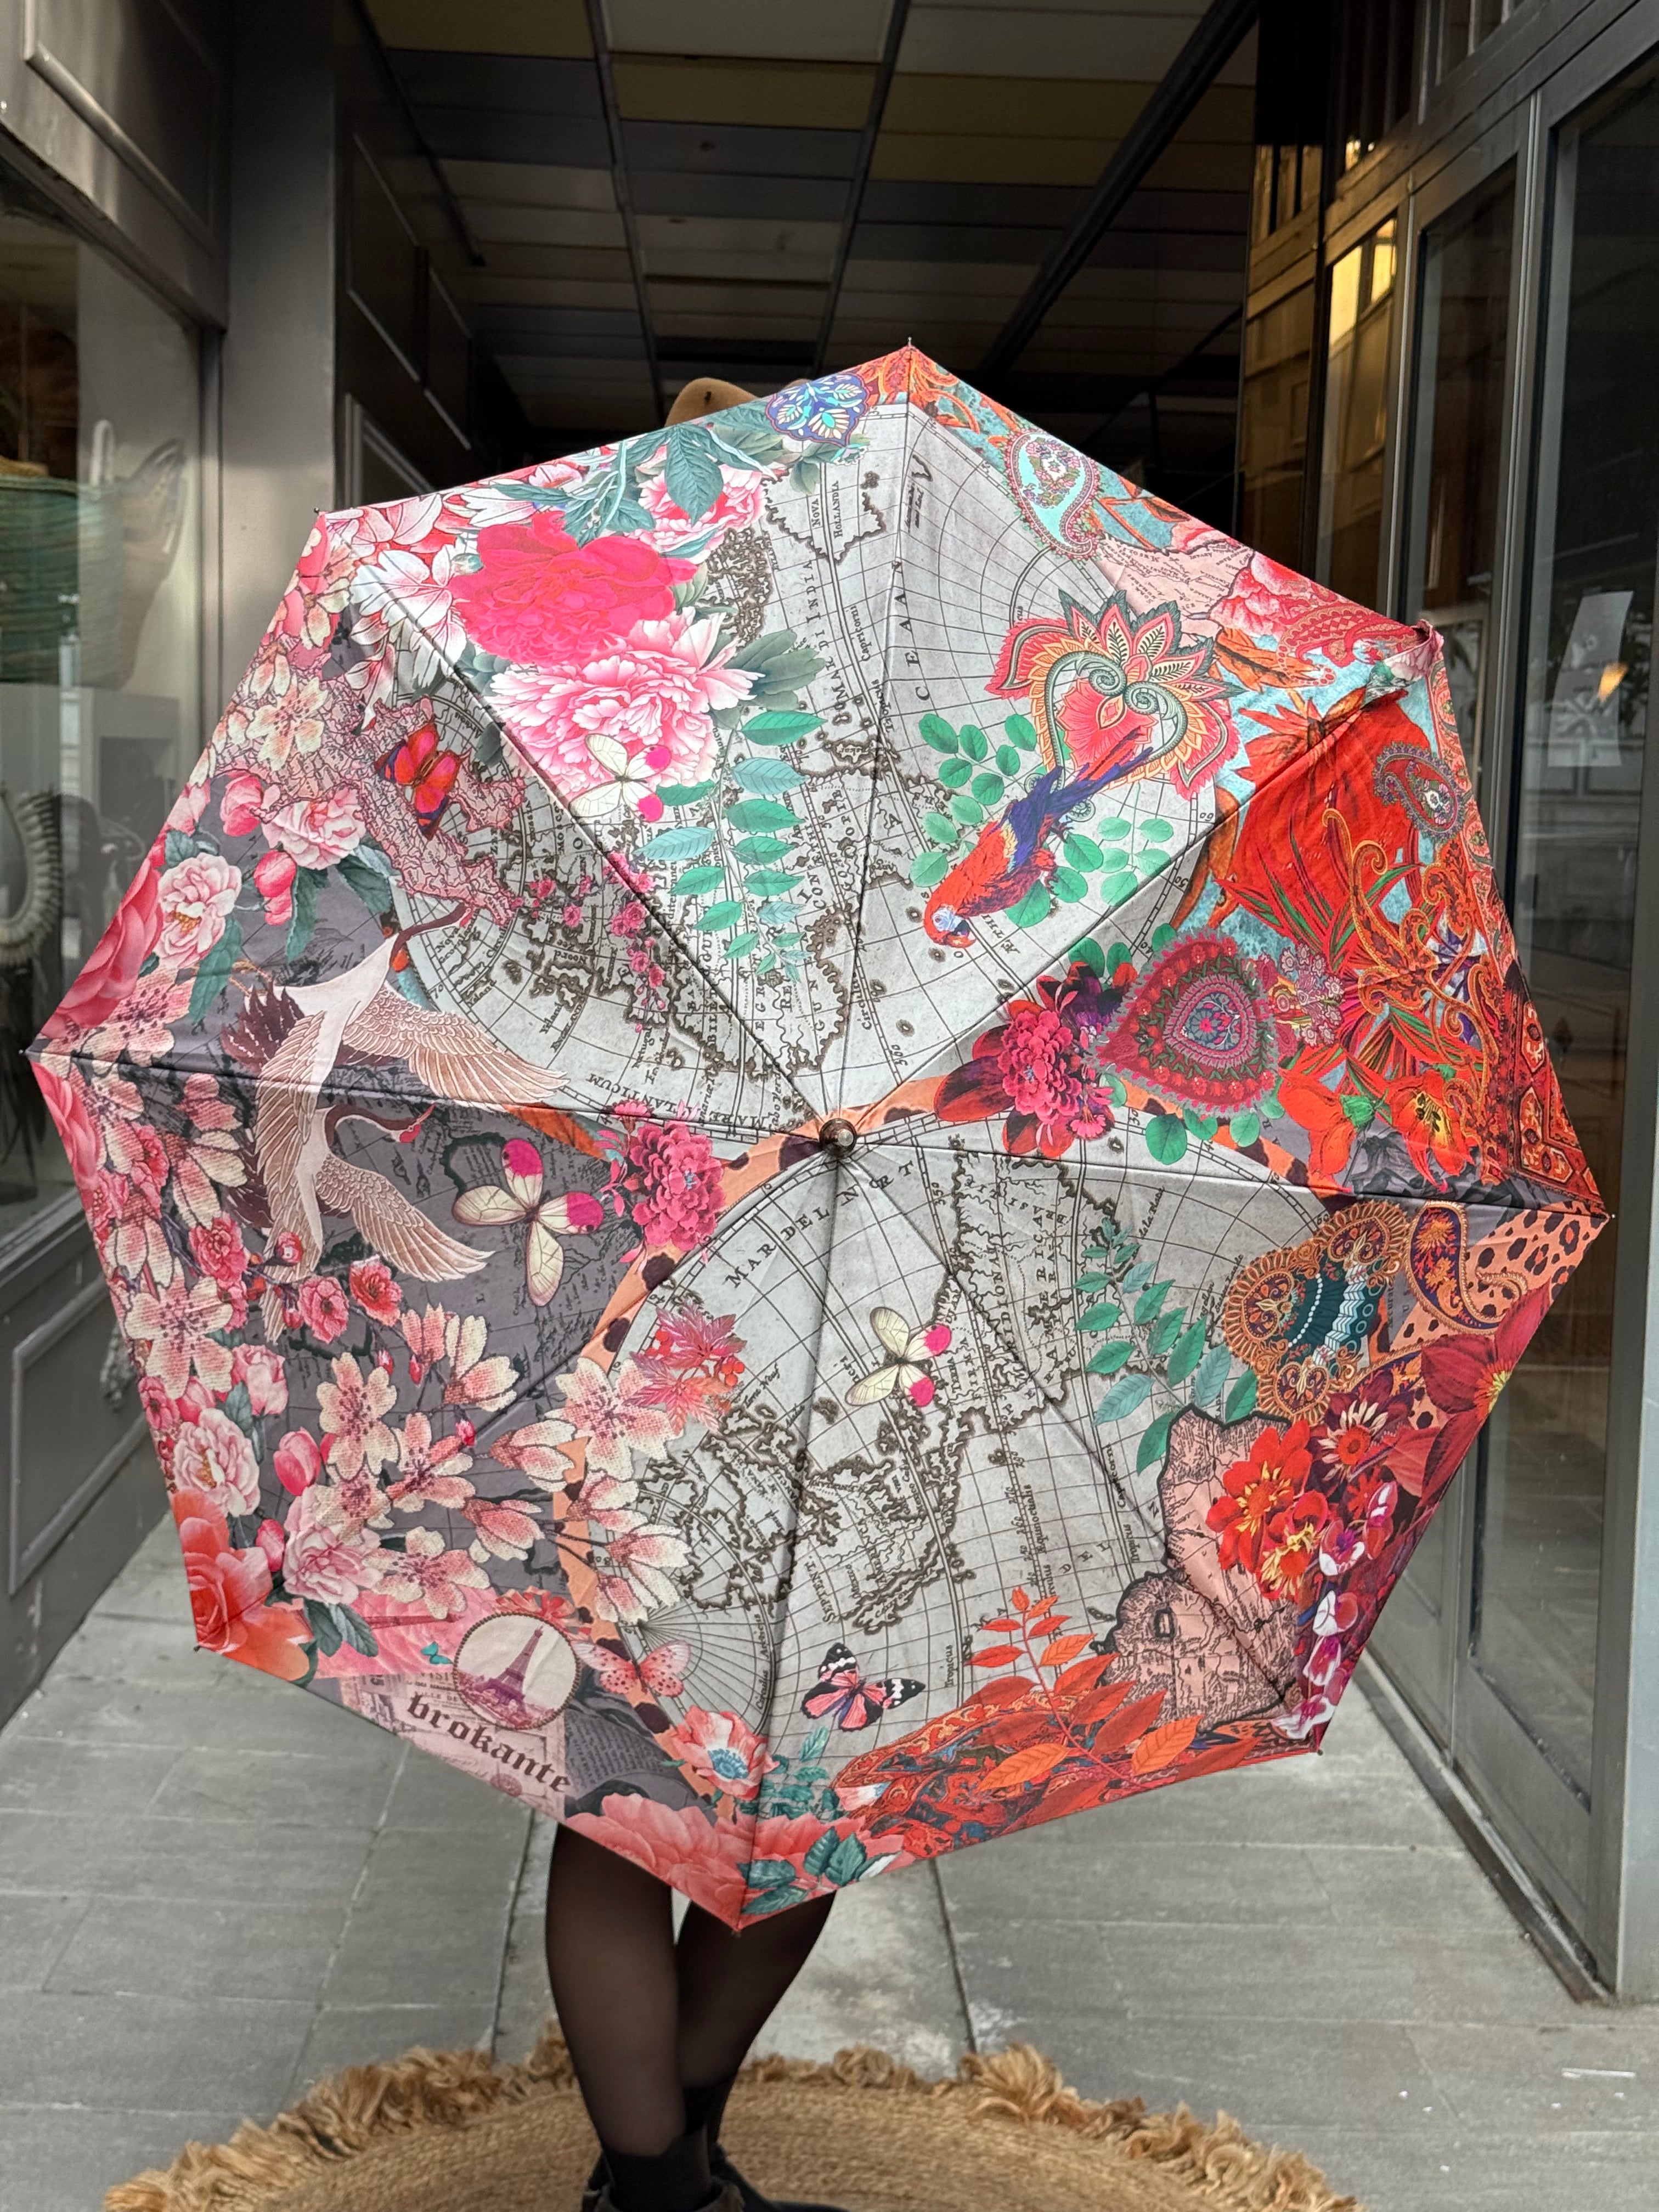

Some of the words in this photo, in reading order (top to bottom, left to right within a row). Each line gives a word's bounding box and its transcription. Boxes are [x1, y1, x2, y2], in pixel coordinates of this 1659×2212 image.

[811, 498, 821, 527] NOVA
[831, 481, 843, 539] HOLLANDIA
[802, 559, 821, 623] INDIA
[815, 630, 829, 651] DI
[428, 983, 444, 1000] 70
[1127, 1110, 1139, 1126] 30
[930, 1181, 947, 1206] 350
[1316, 1213, 1330, 1226] 60
[722, 1243, 777, 1289] MAR
[780, 1206, 831, 1242] DEL
[1059, 1543, 1111, 1575] DEL
[944, 1643, 955, 1689] Tropicus
[407, 1693, 572, 1793] brokante
